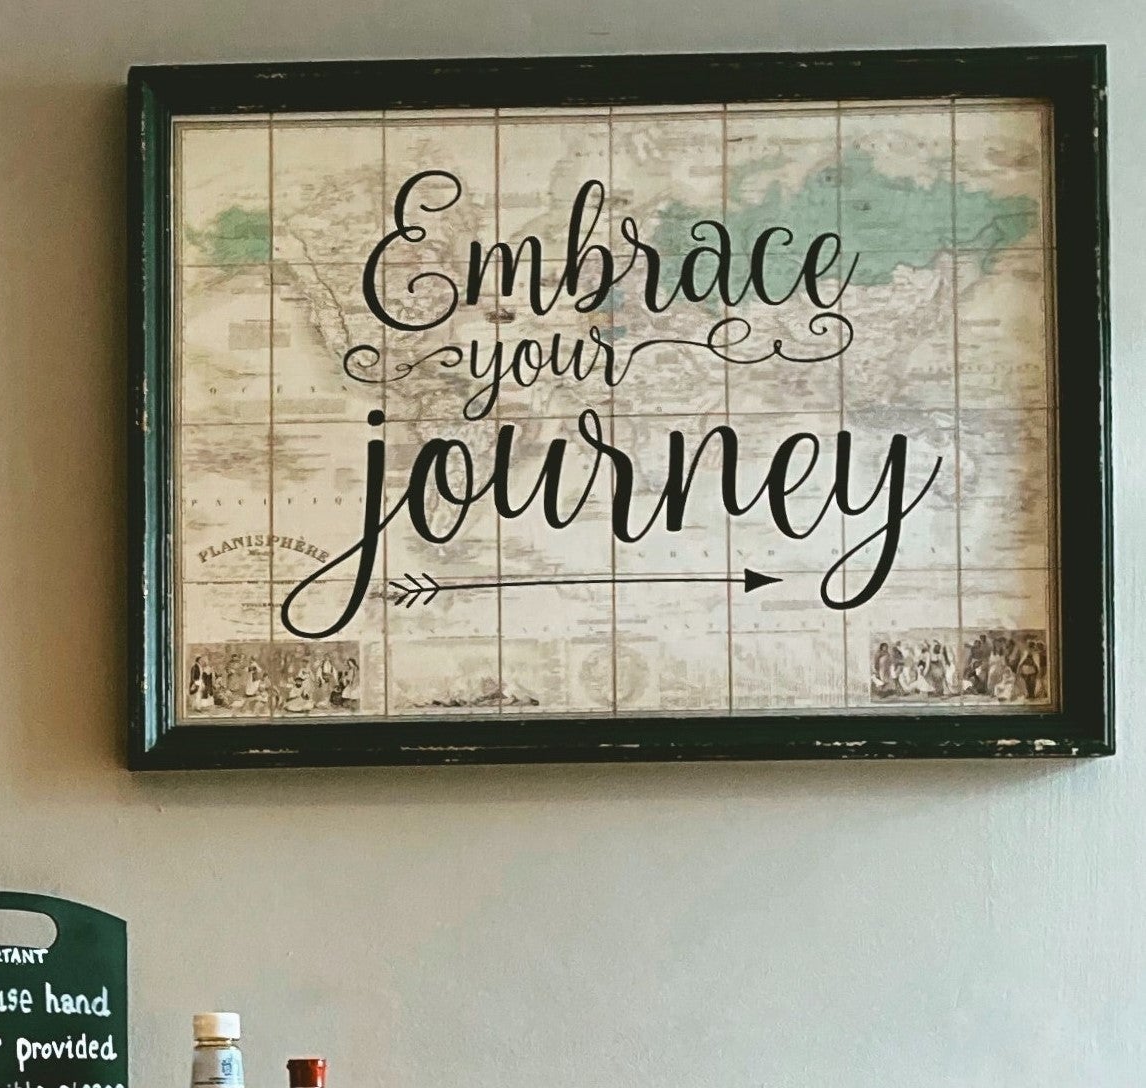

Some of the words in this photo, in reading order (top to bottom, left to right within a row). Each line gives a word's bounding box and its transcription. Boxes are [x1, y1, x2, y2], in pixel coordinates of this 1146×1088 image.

[362, 170, 860, 332] Embrace
[281, 409, 943, 639] journey
[198, 534, 330, 564] PLANISPHÈRE
[45, 982, 111, 1018] hand
[16, 1033, 118, 1073] provided
